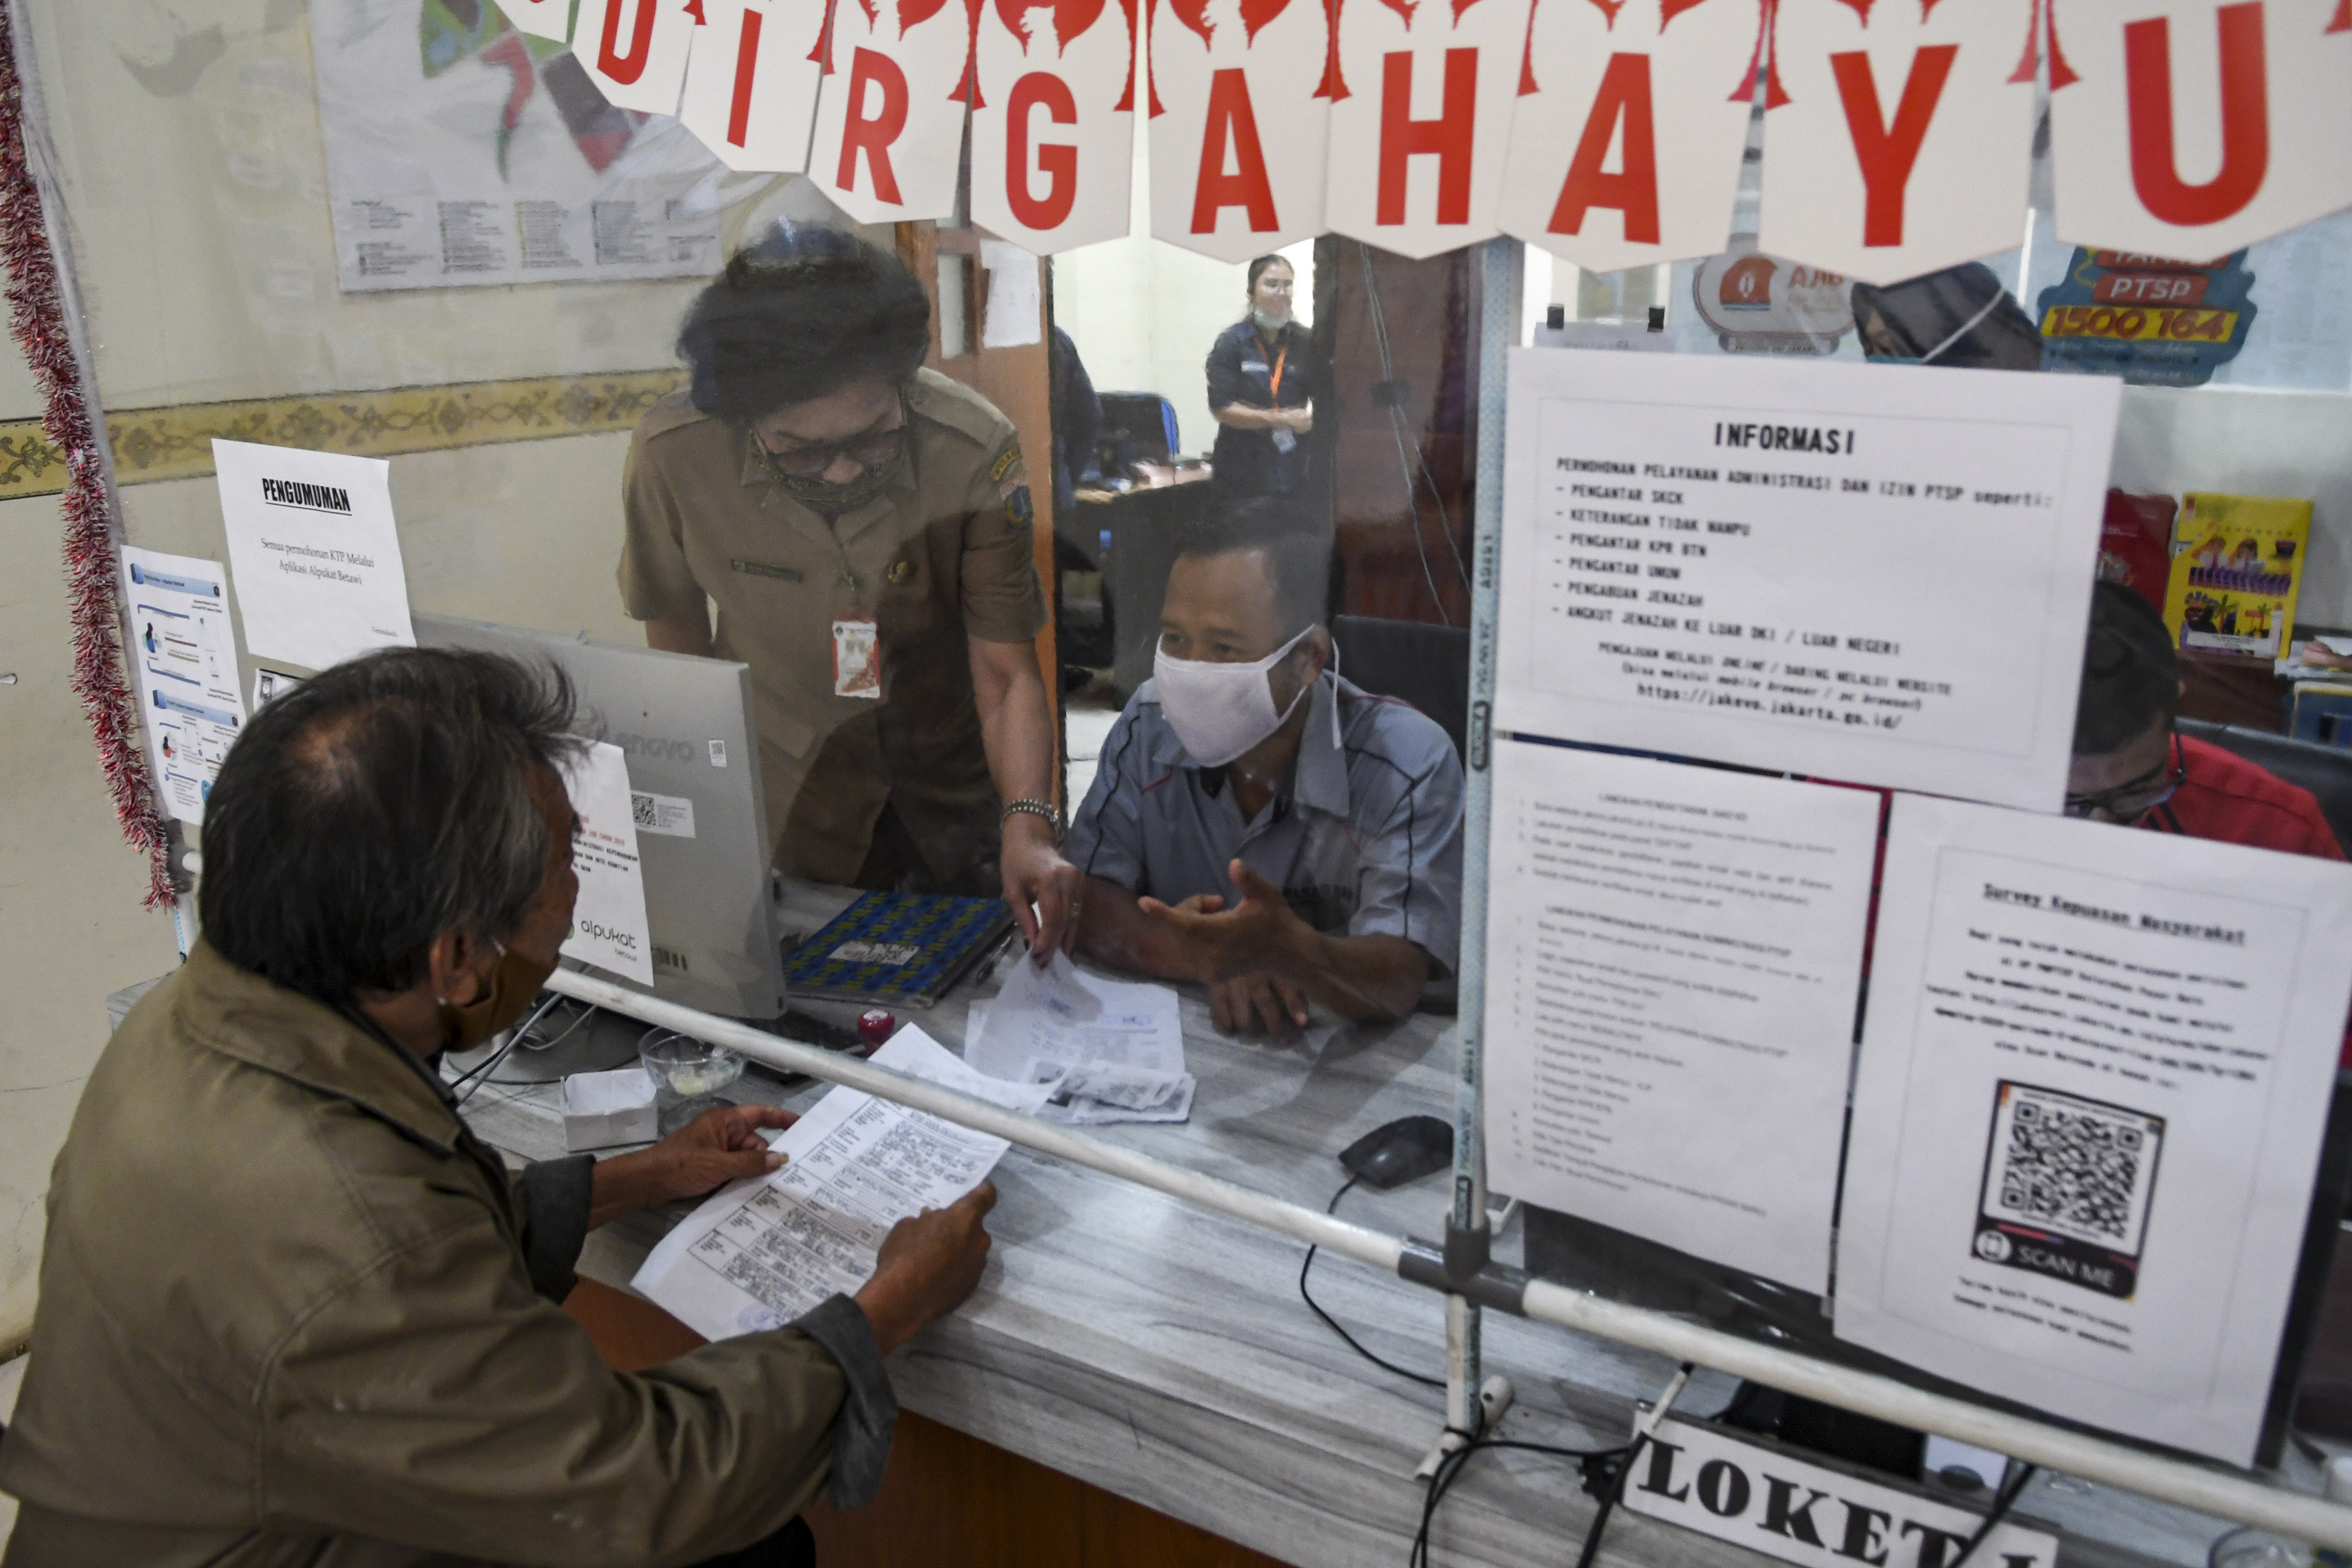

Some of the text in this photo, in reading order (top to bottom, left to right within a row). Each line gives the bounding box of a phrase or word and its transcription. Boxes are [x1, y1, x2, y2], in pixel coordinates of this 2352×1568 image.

[2109, 278, 2191, 299] PTSP
[2052, 307, 2226, 339] 1500 164
[1713, 422, 1855, 455] INFORMASI
[262, 477, 351, 511] PENGUMUMAN
[1571, 483, 1643, 502] PENGANTAR
[1643, 464, 1719, 482] PELAYANAN
[1726, 470, 1831, 491] ADMINISTRASI
[1840, 478, 1870, 494] DAN
[1924, 484, 1964, 502] PTSP
[1570, 509, 1651, 527] KETERANGAN
[1659, 516, 1699, 531] TIDAK
[261, 538, 374, 568] Semua permohonan KTP Melalui
[1570, 532, 1642, 551] PENGANTAR
[279, 560, 362, 585] Aplikasi Alpukat Betawi
[1569, 557, 1639, 575] PENGANTAR
[581, 920, 636, 949] alpukat
[2017, 1245, 2115, 1289] SCAN ME
[1638, 1433, 1971, 1568] LOKET
